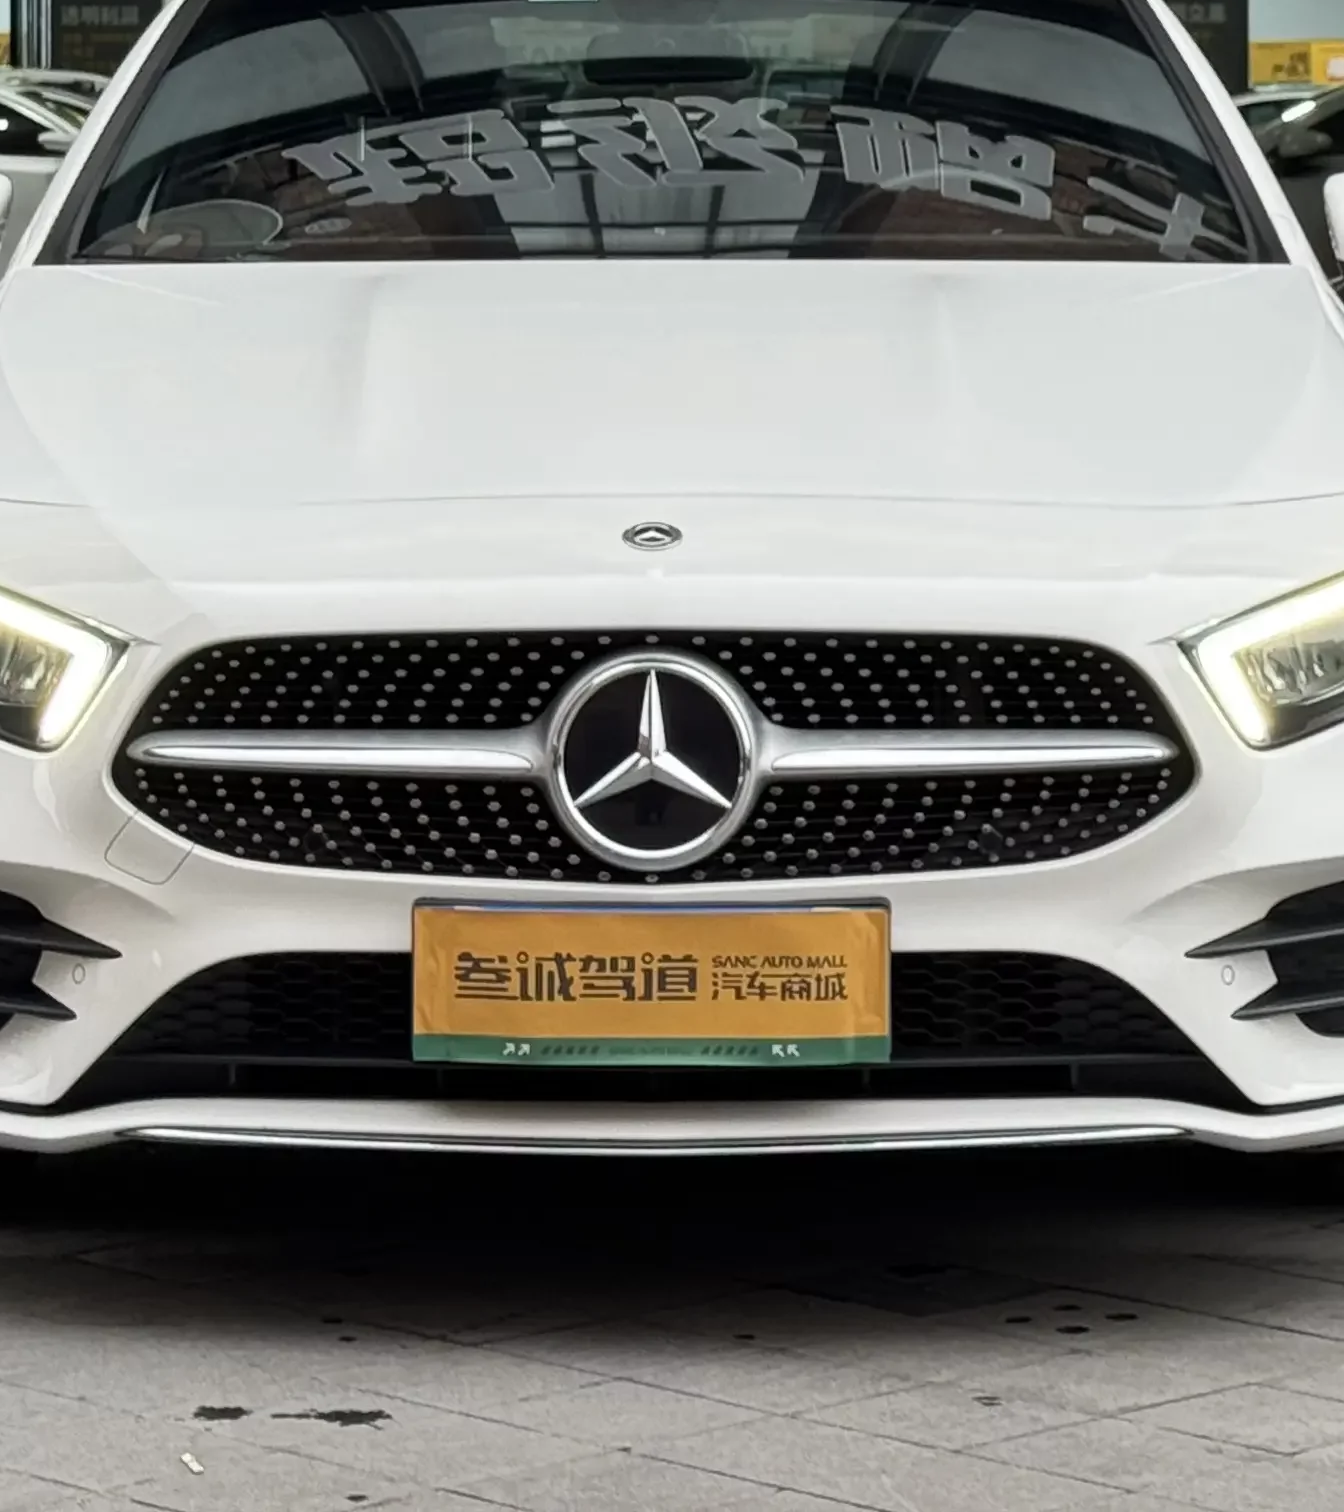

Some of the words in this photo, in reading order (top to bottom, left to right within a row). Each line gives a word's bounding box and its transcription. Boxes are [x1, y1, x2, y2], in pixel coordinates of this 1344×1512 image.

[761, 955, 804, 969] AUTO
[807, 954, 848, 969] MALL
[455, 951, 699, 1003] 叁诚驾道
[711, 972, 849, 1002] 汽车商城
